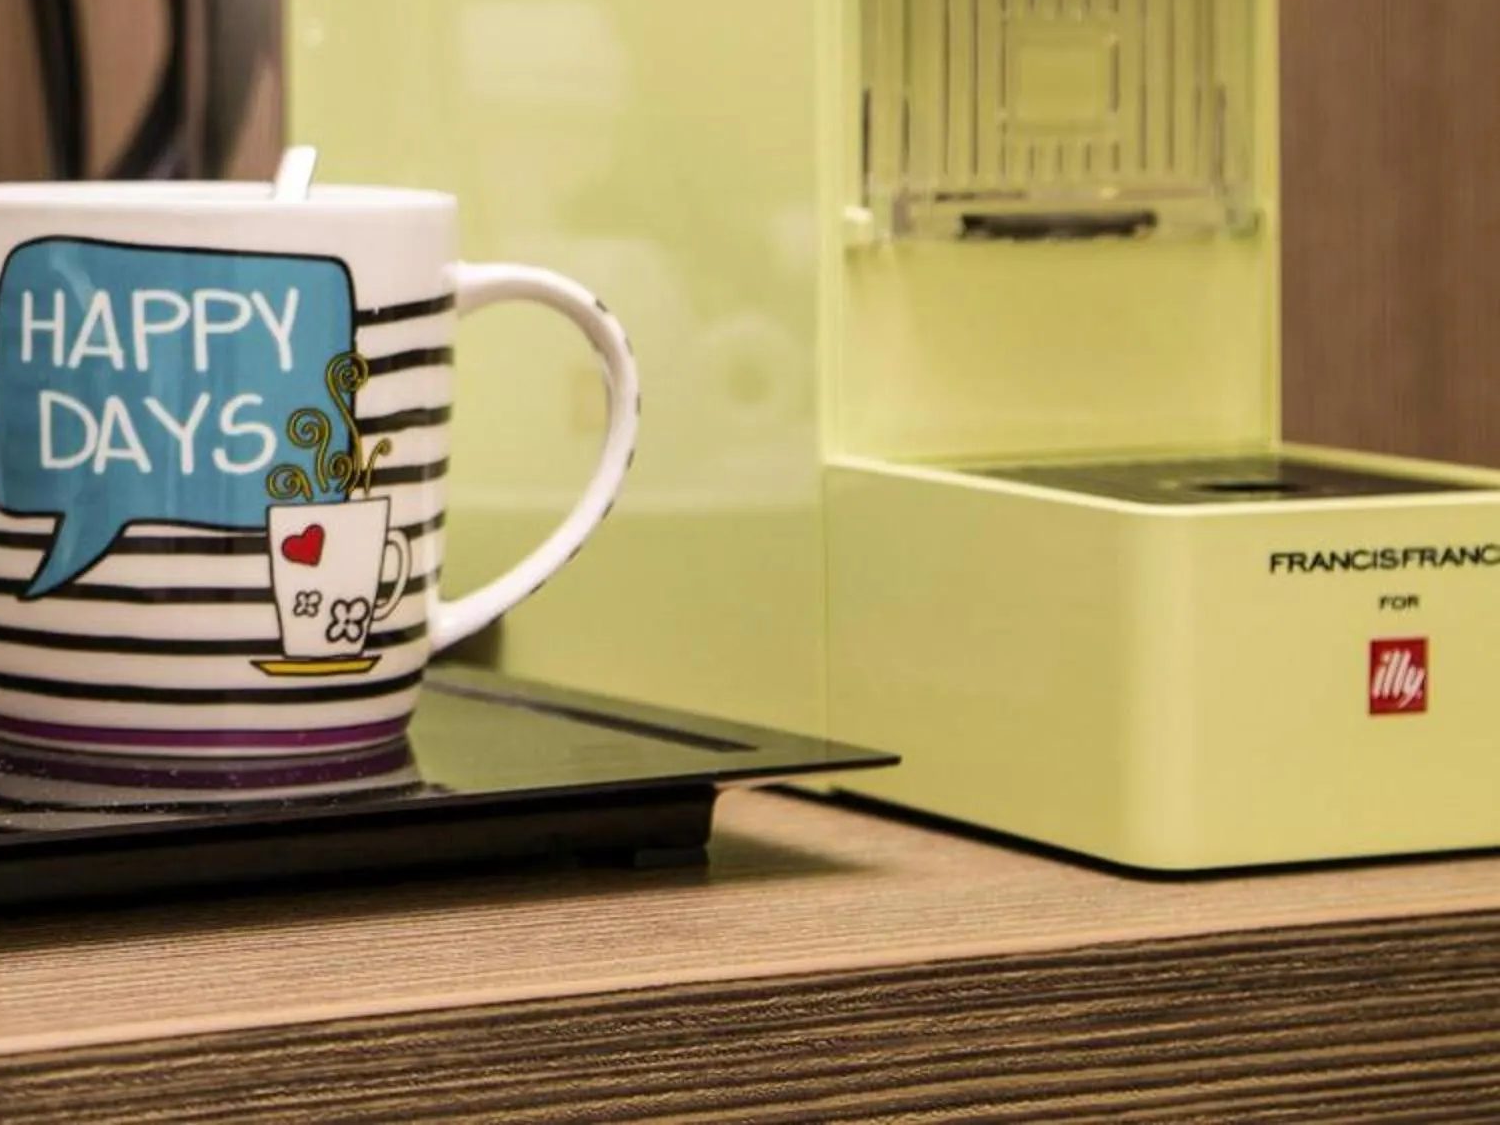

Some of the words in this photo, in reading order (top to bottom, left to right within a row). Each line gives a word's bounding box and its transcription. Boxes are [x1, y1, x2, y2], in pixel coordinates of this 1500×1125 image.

[20, 287, 300, 372] HAPPY
[39, 390, 277, 475] DAYS
[1378, 594, 1420, 610] FOR
[1372, 648, 1425, 708] illy
